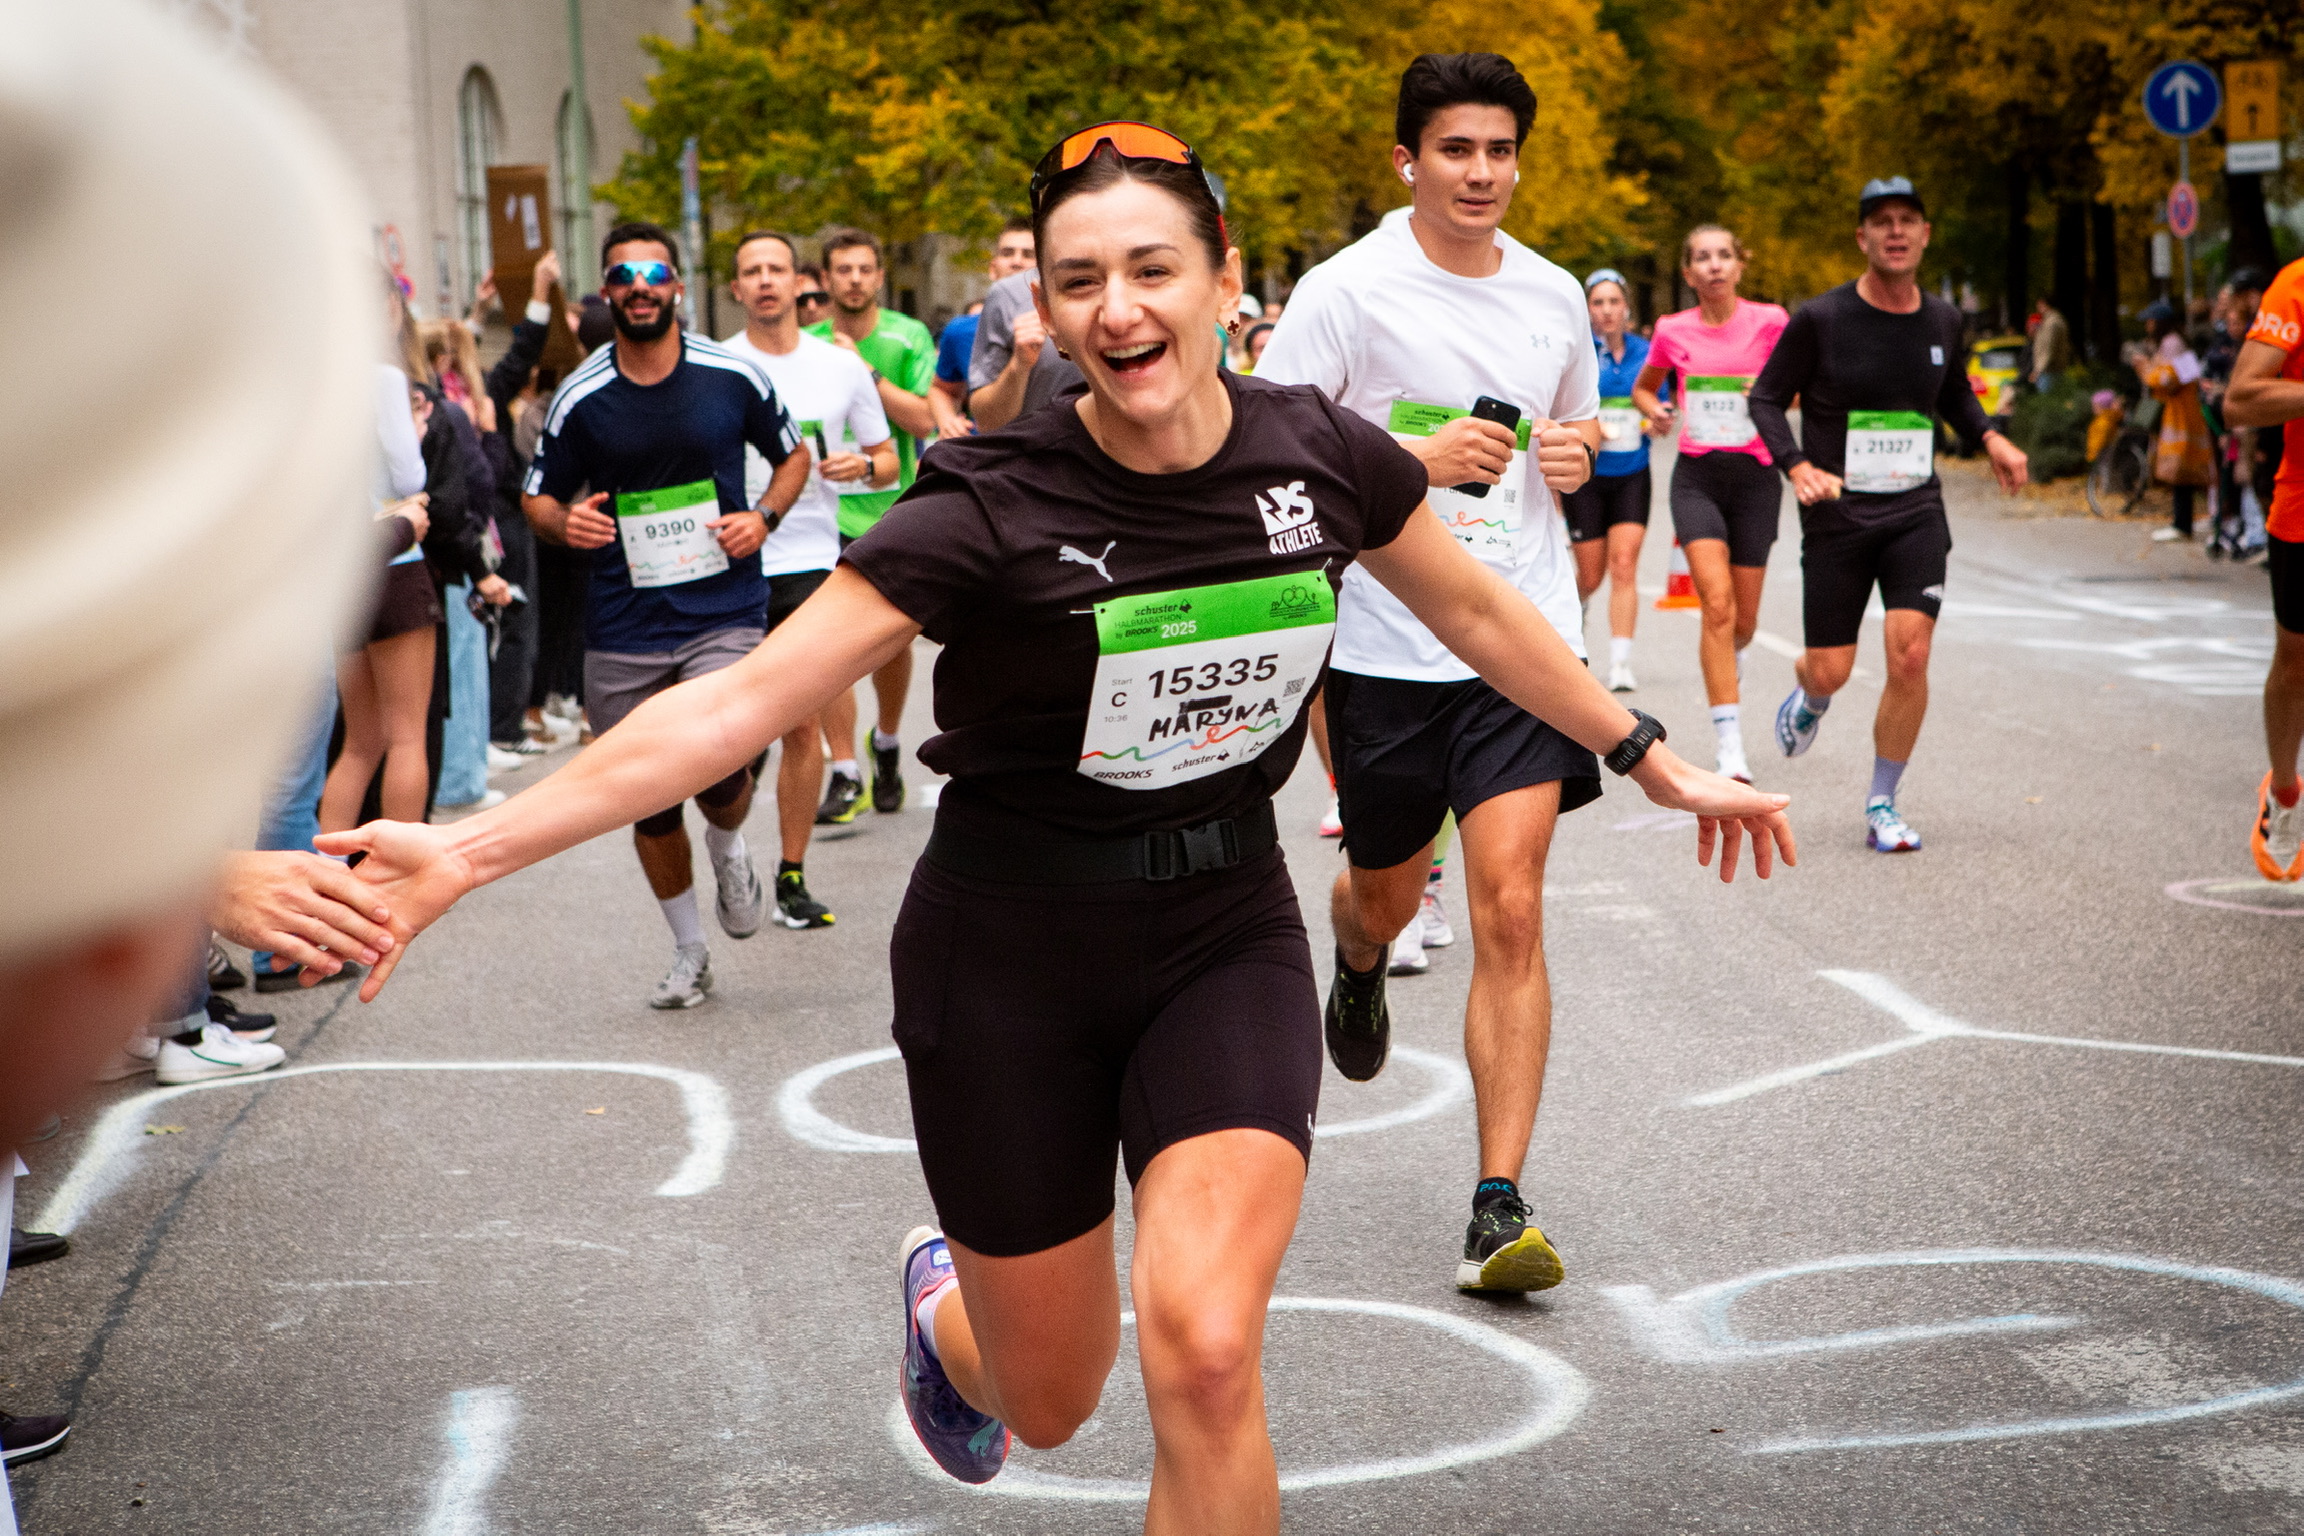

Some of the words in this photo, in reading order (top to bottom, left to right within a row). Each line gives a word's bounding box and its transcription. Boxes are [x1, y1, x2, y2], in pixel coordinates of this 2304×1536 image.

[1428, 423, 1445, 433] 20
[1867, 438, 1913, 454] 21327
[645, 518, 695, 539] 9390
[1269, 521, 1323, 555] ATHLETE
[1135, 603, 1177, 616] schuster
[1115, 613, 1182, 629] HALBMARATHON
[1125, 626, 1158, 638] BROOKS
[1161, 620, 1197, 639] 2025
[1111, 678, 1133, 686] Start
[1148, 654, 1279, 698] 15335
[1111, 692, 1128, 707] C
[1104, 714, 1128, 723] 10:36
[1148, 697, 1280, 742] MARYNA
[1171, 754, 1217, 772] schuster
[1093, 768, 1155, 780] BROOKS
